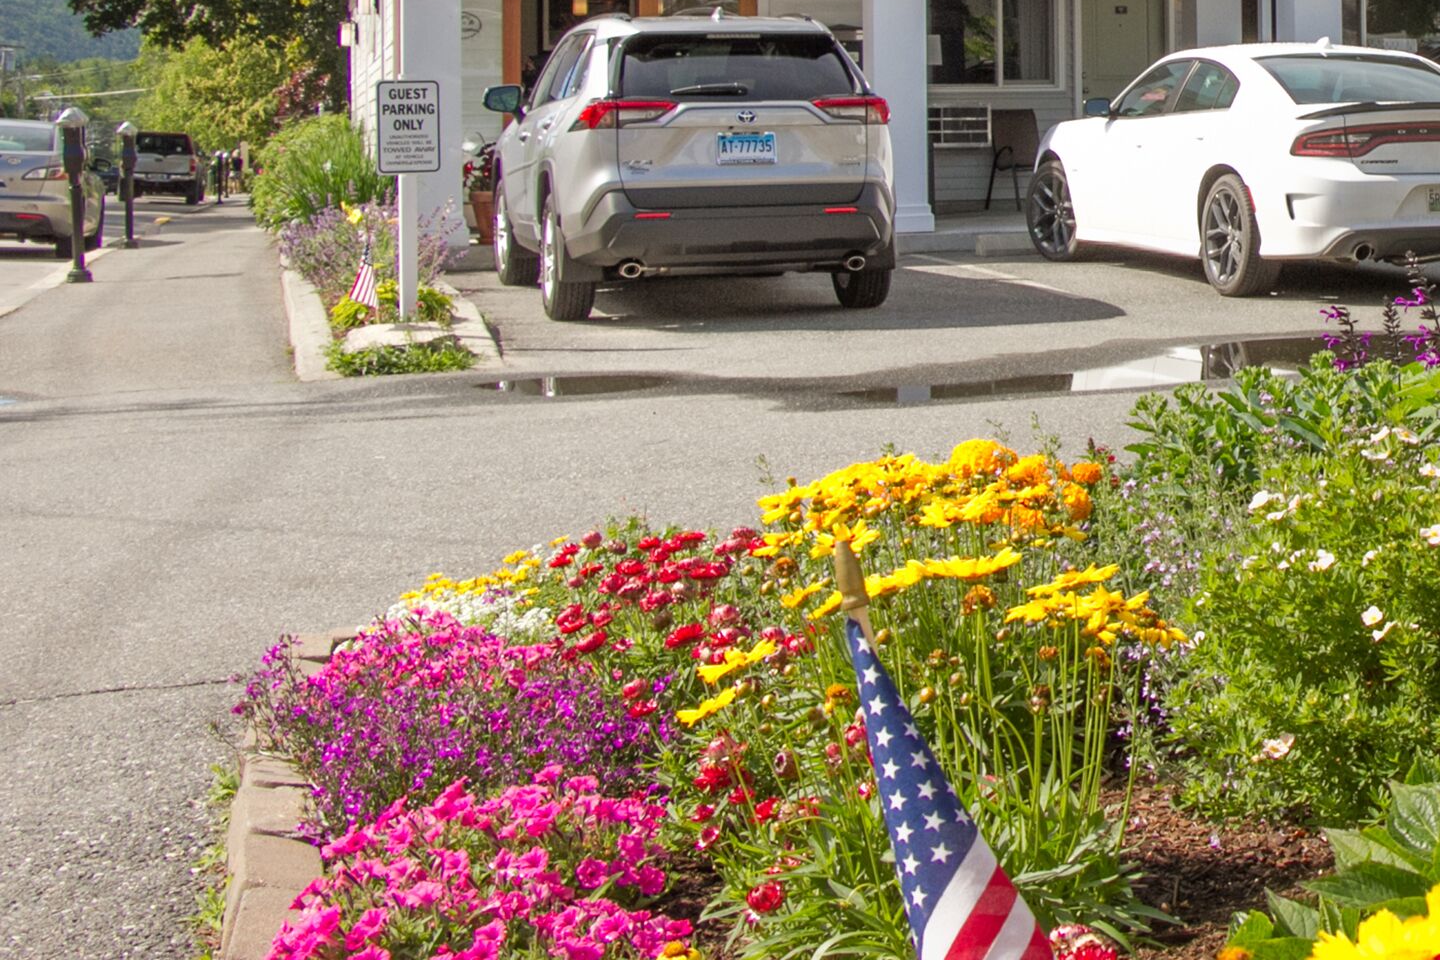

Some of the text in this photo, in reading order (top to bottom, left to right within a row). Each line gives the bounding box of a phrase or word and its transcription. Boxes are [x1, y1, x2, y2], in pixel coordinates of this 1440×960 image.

[388, 88, 428, 100] GUEST
[382, 103, 435, 115] PARKING
[393, 119, 424, 131] ONLY
